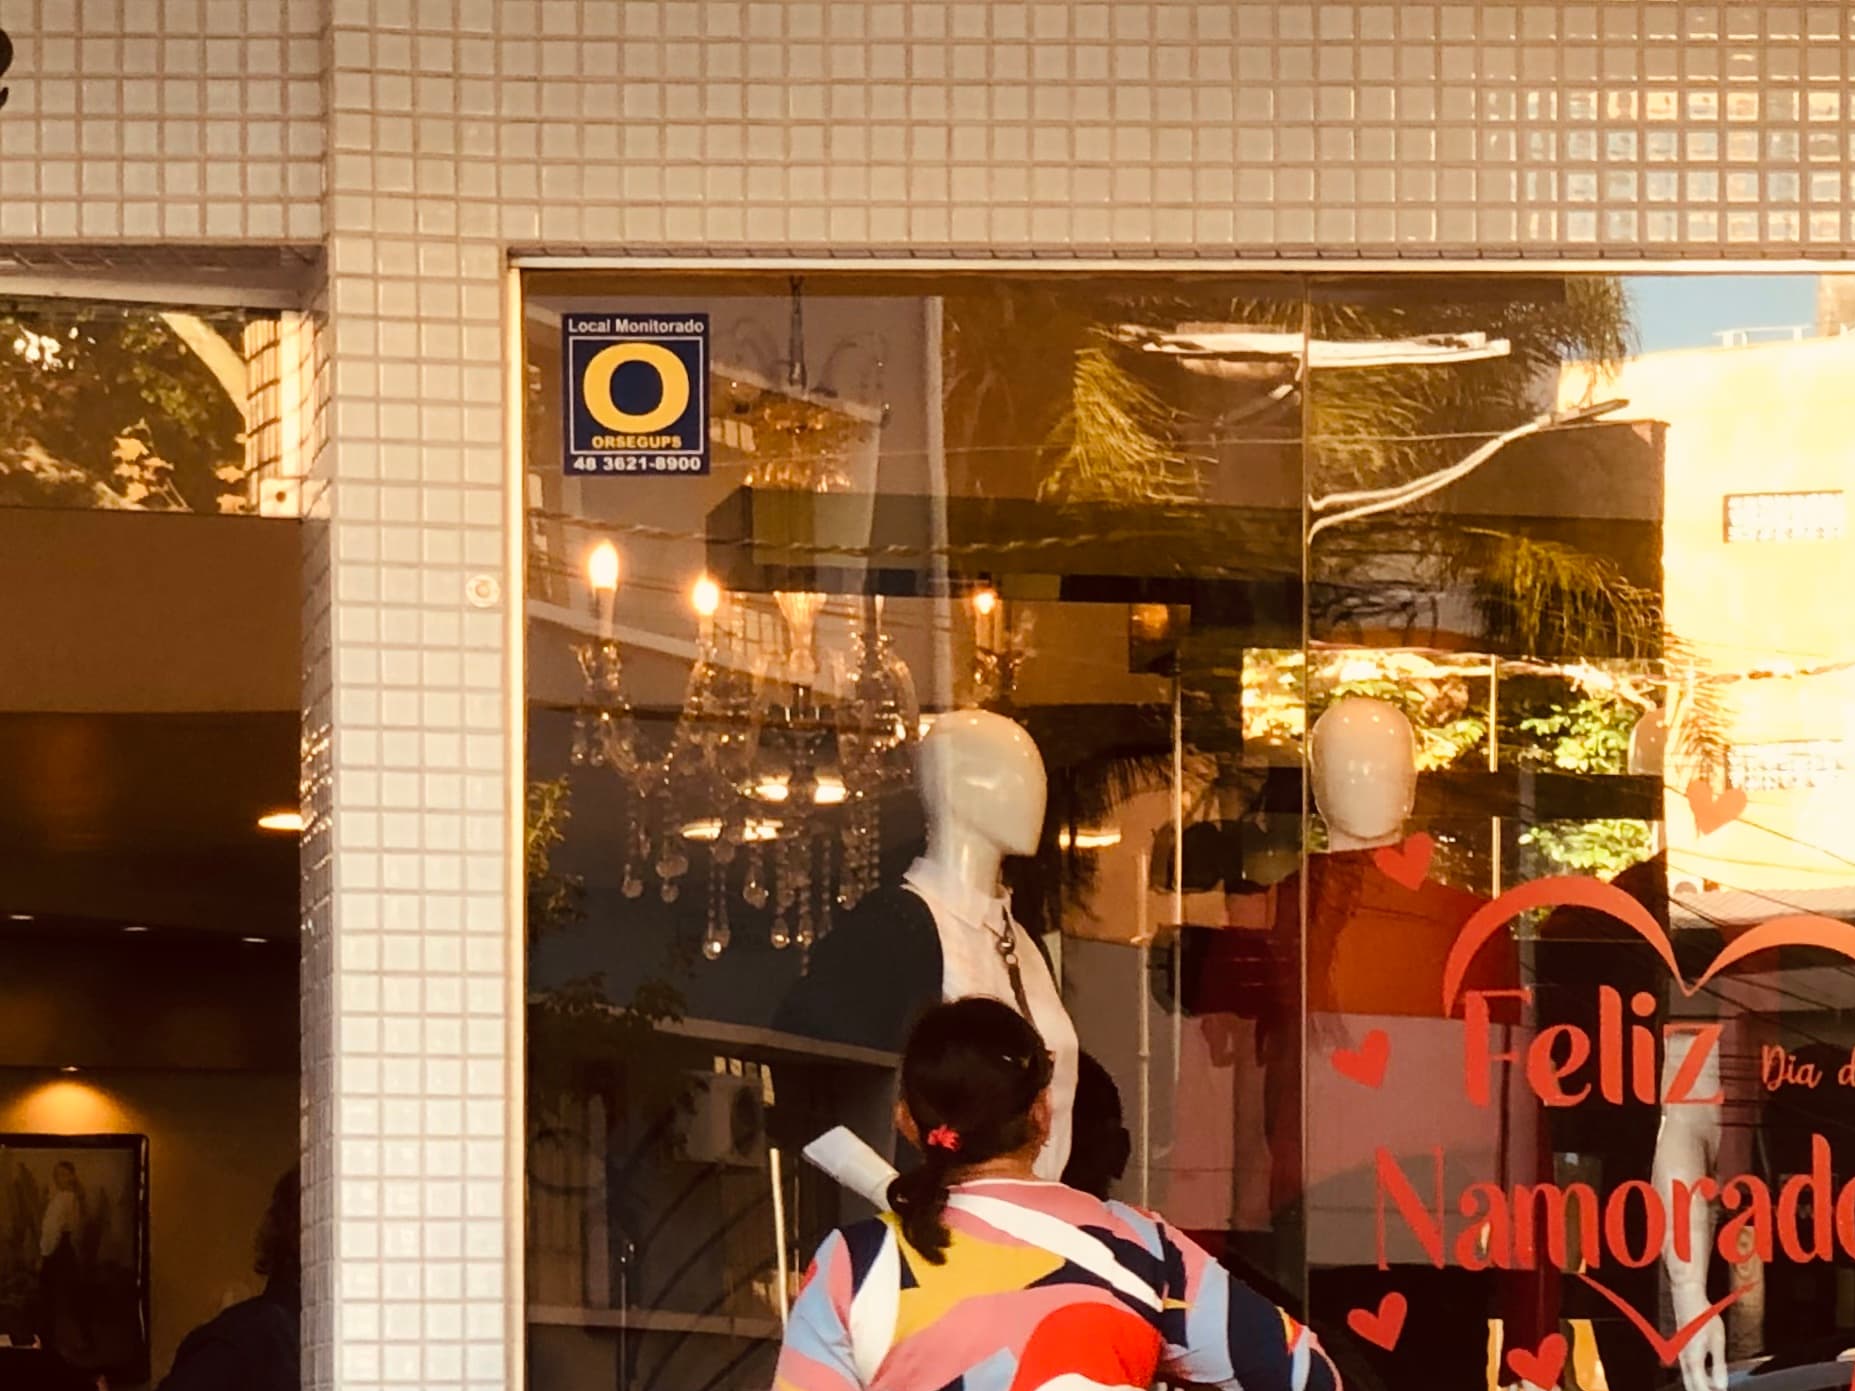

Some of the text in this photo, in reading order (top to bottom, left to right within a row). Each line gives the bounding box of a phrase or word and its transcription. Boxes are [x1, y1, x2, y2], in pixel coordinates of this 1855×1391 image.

[568, 318, 704, 333] Local Monitorado
[592, 436, 682, 449] ORSEGUPS
[573, 456, 701, 471] 48 3621-8900
[1461, 984, 1725, 1108] Feliz
[1761, 1044, 1823, 1092] Dia
